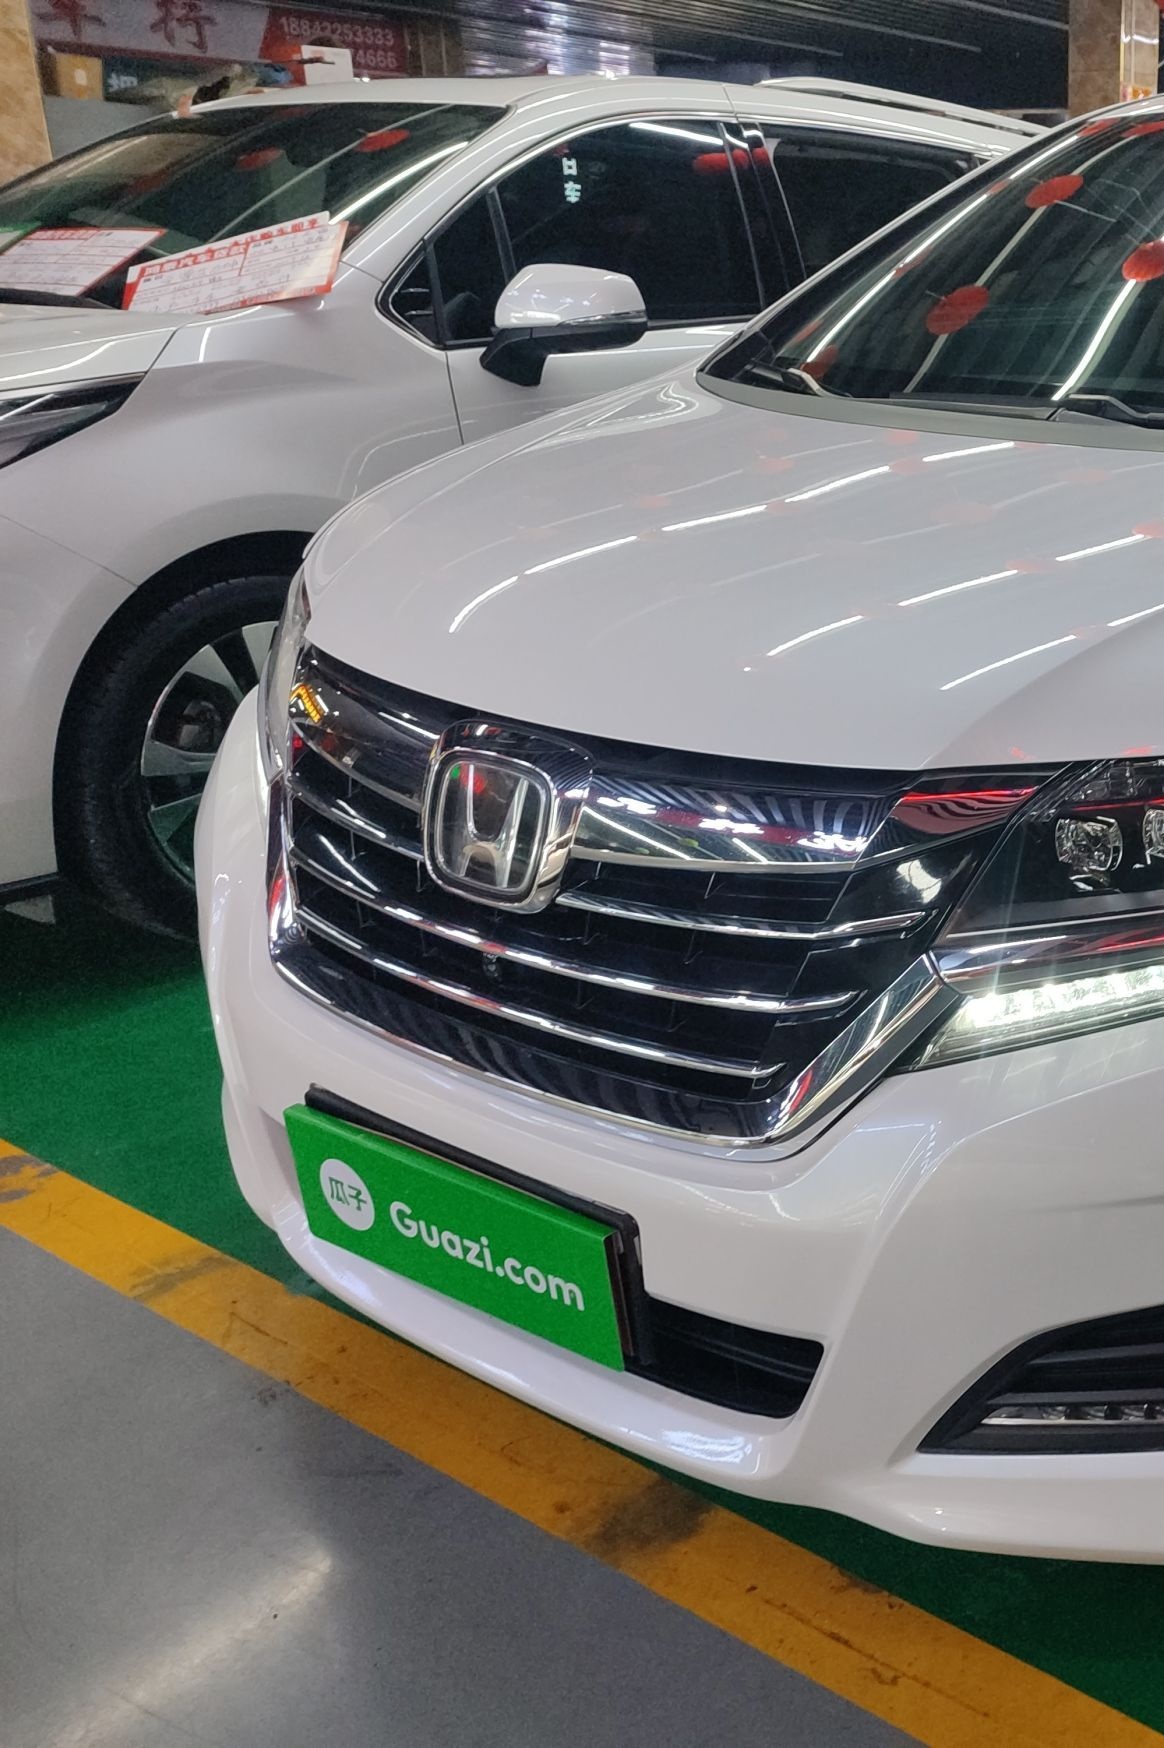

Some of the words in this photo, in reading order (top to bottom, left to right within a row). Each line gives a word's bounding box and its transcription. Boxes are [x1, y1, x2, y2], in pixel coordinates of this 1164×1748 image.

[352, 49, 397, 68] 4666
[327, 1176, 368, 1213] 瓜子
[389, 1200, 585, 1312] Guazi.com
